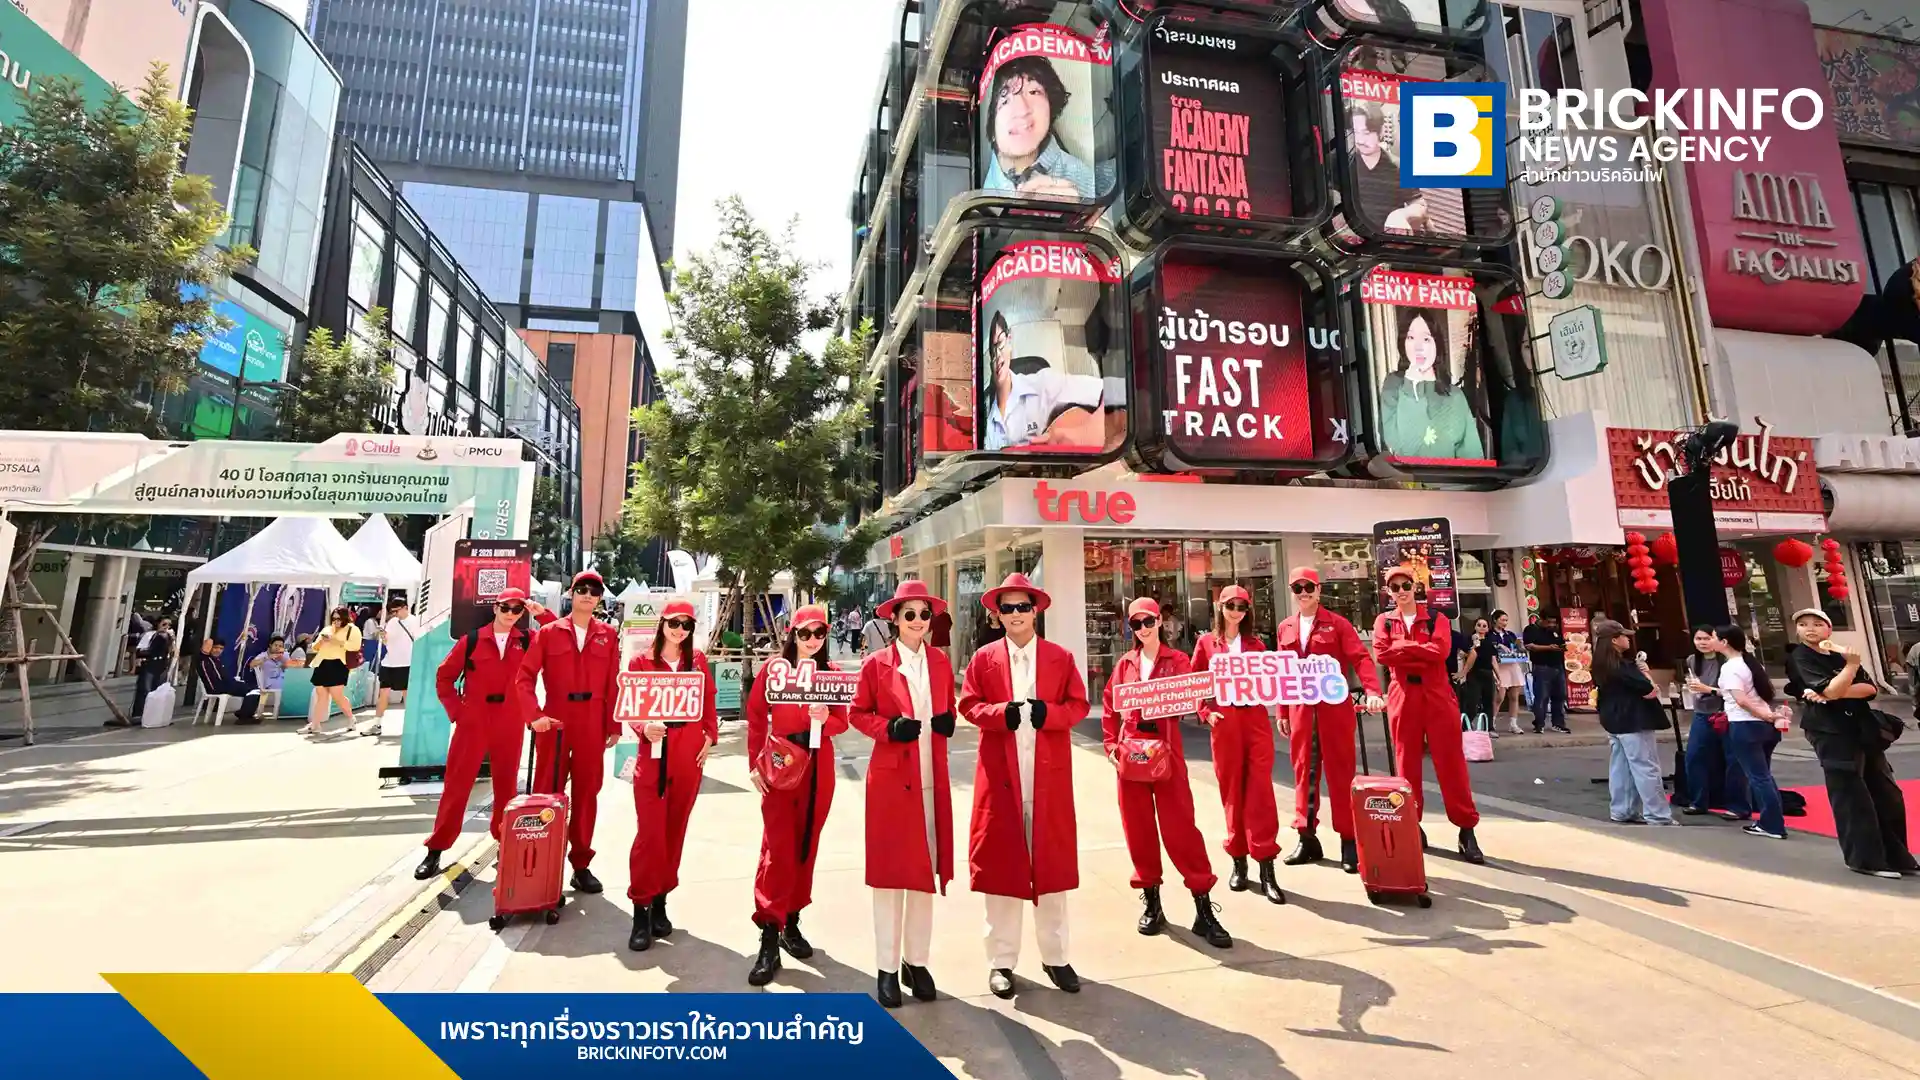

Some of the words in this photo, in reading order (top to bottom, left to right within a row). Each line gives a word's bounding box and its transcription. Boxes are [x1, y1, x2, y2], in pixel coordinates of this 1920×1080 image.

[994, 34, 1086, 67] ACADEMY
[1161, 71, 1240, 93] ประกาศผล
[1170, 94, 1202, 109] true
[1170, 106, 1250, 156] ACADEMY
[1163, 148, 1249, 199] FANTASIA
[1775, 231, 1805, 247] THE
[996, 254, 1094, 285] ACADEMY
[1158, 306, 1290, 350] ผู้เข้ารอบ
[1175, 354, 1263, 408] FAST
[1162, 409, 1283, 440] TRACK
[361, 438, 401, 454] Chula
[468, 447, 502, 456] PMCU
[219, 469, 239, 481] 40
[244, 467, 255, 481] ปี
[259, 467, 328, 484] โอสถศาลา
[332, 471, 449, 489] จากร้านยาคุณภาพ
[134, 482, 448, 505] สู่ศูนย์กลางแห่งความห่วงใยสุขภาพของคนไทย
[1032, 480, 1137, 524] true
[494, 499, 510, 540] URES
[770, 660, 812, 692] 3-4
[1213, 655, 1294, 676] #BEST
[1297, 658, 1337, 674] with
[621, 676, 648, 686] true
[1119, 676, 1211, 697] #TrueVisionsNow
[1215, 674, 1345, 701] TRUE5G
[618, 686, 648, 717] AF
[648, 686, 701, 717] 2026
[769, 692, 779, 700] TK
[782, 692, 802, 700] PARK
[804, 693, 838, 701] CENTRAL
[1122, 686, 1213, 708] #TrueAFthailand
[1145, 701, 1193, 716] #AF2026
